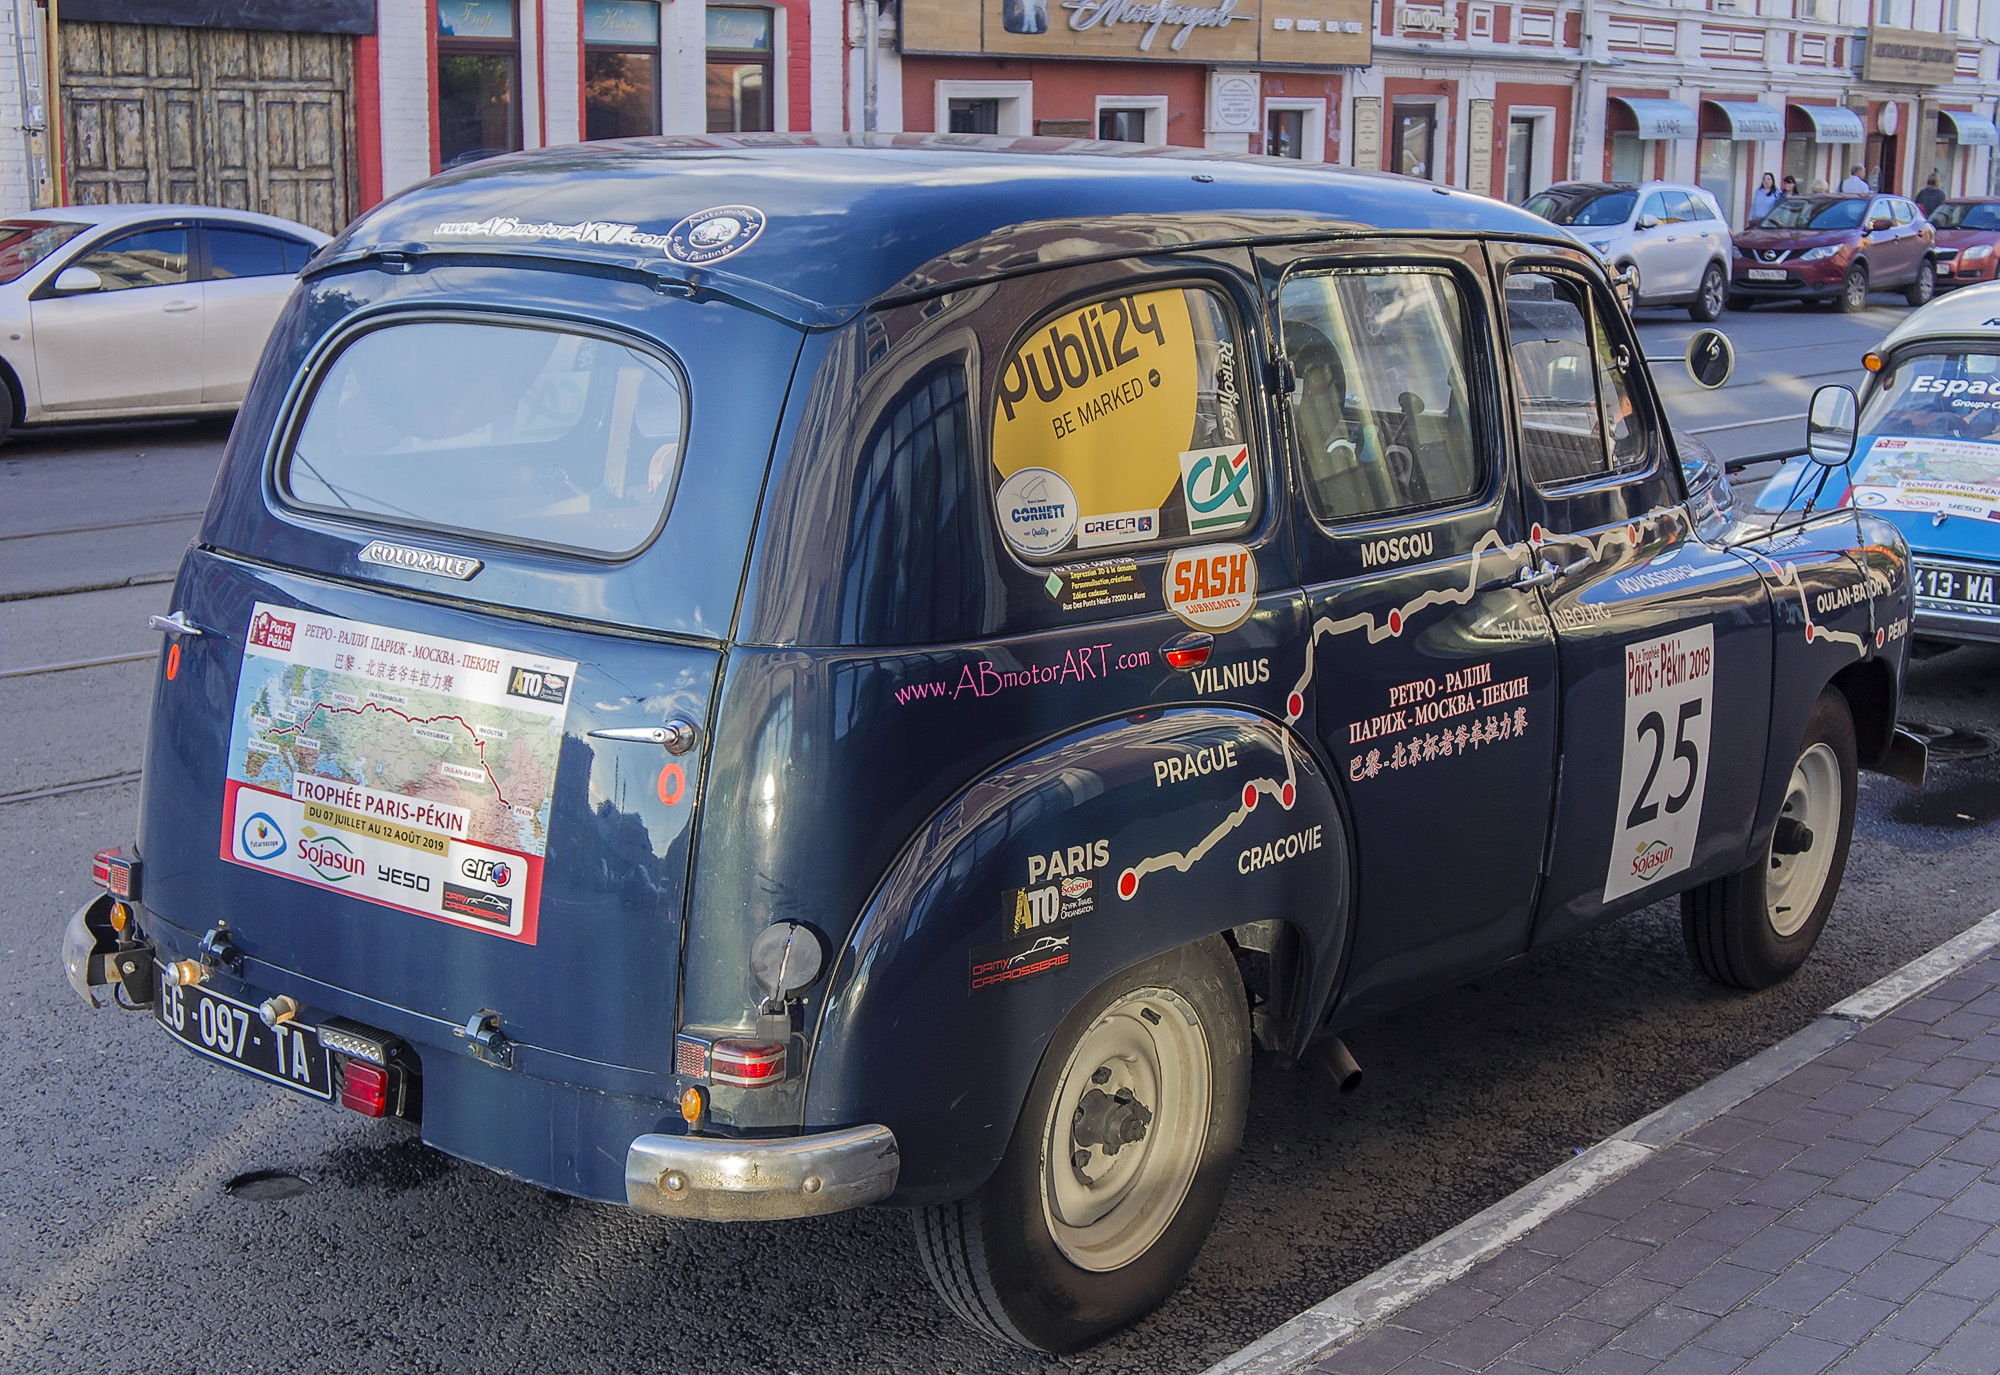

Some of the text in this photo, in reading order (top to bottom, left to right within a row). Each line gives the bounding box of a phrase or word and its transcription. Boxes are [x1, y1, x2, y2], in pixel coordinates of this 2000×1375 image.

[1656, 119, 1682, 134] КОФЕ
[688, 209, 754, 229] Automotive
[434, 217, 671, 248] www.ABmotorART.com
[686, 244, 734, 261] Paintings
[999, 296, 1165, 421] publi24
[1052, 376, 1144, 440] BE MARKED
[1952, 399, 1991, 409] Groupe
[1900, 480, 1943, 489] TROPHÉE
[1012, 504, 1065, 523] CORNETT
[1896, 498, 1940, 508] Sojasun
[1948, 502, 1982, 513] YESO
[1085, 518, 1136, 534] ORECA
[370, 546, 467, 576] COLORALE
[1360, 531, 1434, 568] MOSCOU
[1070, 569, 1098, 580] Impression
[1098, 567, 1106, 576] 3D
[1111, 566, 1116, 574] la
[1173, 553, 1248, 604] SASH
[1615, 564, 1701, 595] NOVOSSIBIRSK
[1072, 592, 1088, 600] Idées
[1967, 574, 1994, 603] WA
[1062, 603, 1073, 612] Rue
[1073, 602, 1083, 610] Des
[1083, 600, 1097, 608] Ponts
[1112, 595, 1127, 603] 72000
[1134, 592, 1146, 600] Mans
[1186, 597, 1241, 615] LUBRICANTS
[269, 620, 293, 636] Paris
[266, 633, 292, 650] Pékin
[304, 624, 333, 641] РЕТРО
[338, 630, 369, 648] РАЛЛИ
[370, 637, 408, 656] ПАРИЖ
[412, 645, 455, 666] МОСКВА
[462, 654, 500, 674] ПЕКИН
[1635, 645, 1660, 663] Le Trophée
[895, 643, 1151, 706] www.ABmotorART.com
[1191, 658, 1270, 696] VILNIUS
[1628, 651, 1652, 699] Paris
[1660, 639, 1687, 689] Pékin
[1689, 646, 1711, 680] 2019
[511, 668, 542, 697] ATO
[1389, 677, 1436, 708] РЕТРО
[1445, 662, 1492, 693] РАЛЛИ
[334, 694, 355, 703] MOSCOU
[256, 716, 268, 724] PARIS
[297, 738, 318, 748] CRACOVIE
[479, 728, 504, 738] IRKOUTSK
[249, 740, 277, 753] FUTUROSCOPE
[444, 766, 482, 780] OULAN-BATOR
[1153, 744, 1239, 787] PRAGUE
[1626, 697, 1702, 830] 25
[296, 779, 464, 832] TROPHÉE PARIS-PÉKIN
[515, 807, 532, 817] PÉKIN
[309, 807, 444, 850] DU 07 JUILLET AU 12 AOÛT 2019
[250, 840, 279, 849] futuroscope
[1238, 824, 1323, 875] CRACOVIE
[297, 839, 365, 876] Sojasun
[462, 858, 494, 882] elf
[1028, 839, 1110, 884] PARIS
[1630, 845, 1674, 876] Sojasun
[378, 865, 430, 892] YESO
[1062, 880, 1093, 896] Sojasun
[1013, 885, 1060, 935] ATO
[972, 953, 1070, 989] CARROSSERIE
[161, 973, 185, 1032] EG
[199, 997, 250, 1059] 097
[271, 1025, 311, 1084] TA
